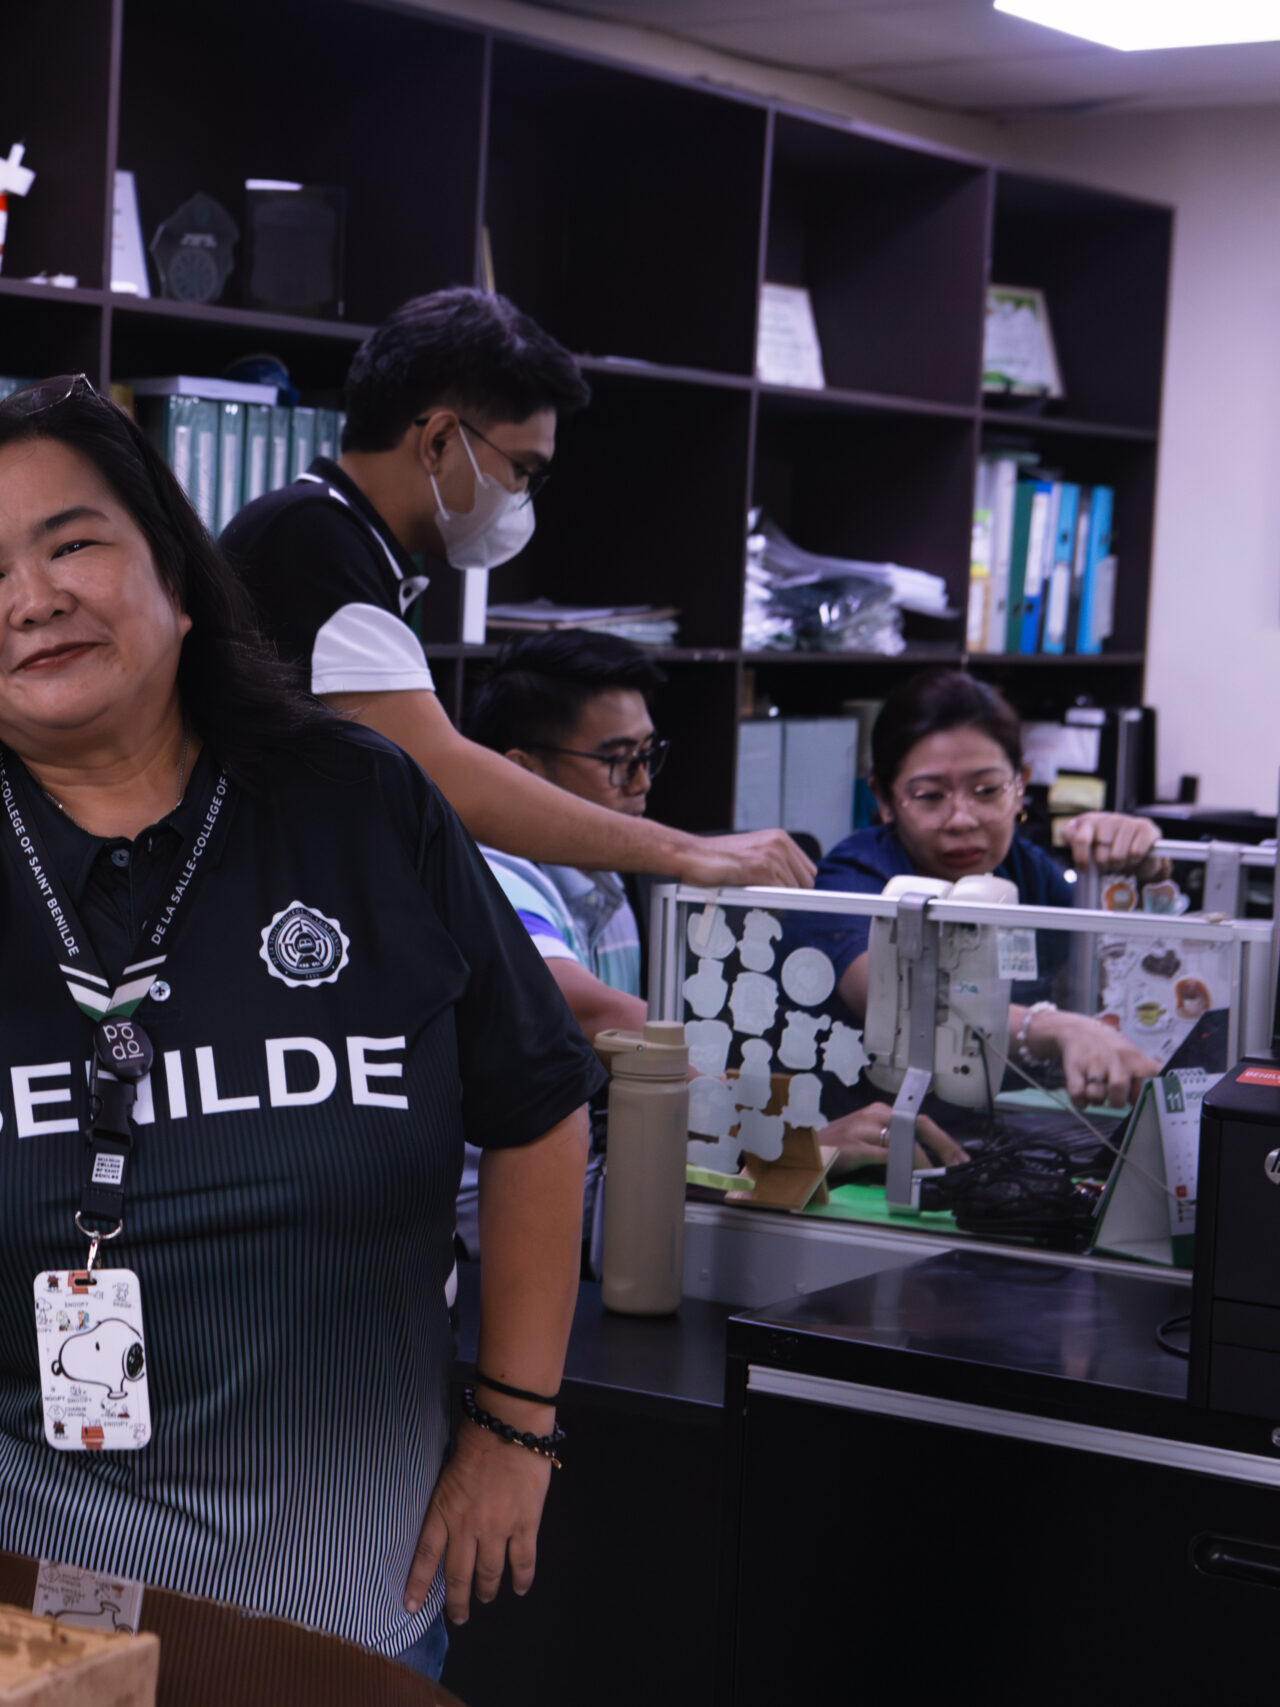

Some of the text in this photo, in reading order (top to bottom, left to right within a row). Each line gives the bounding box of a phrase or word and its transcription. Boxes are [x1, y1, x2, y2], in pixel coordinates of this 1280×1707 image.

[20, 836, 35, 855] OF
[29, 856, 53, 896] SAINT
[46, 897, 80, 957] BENILDE
[151, 776, 229, 945] DE LA SALLE-COLLEGE OF
